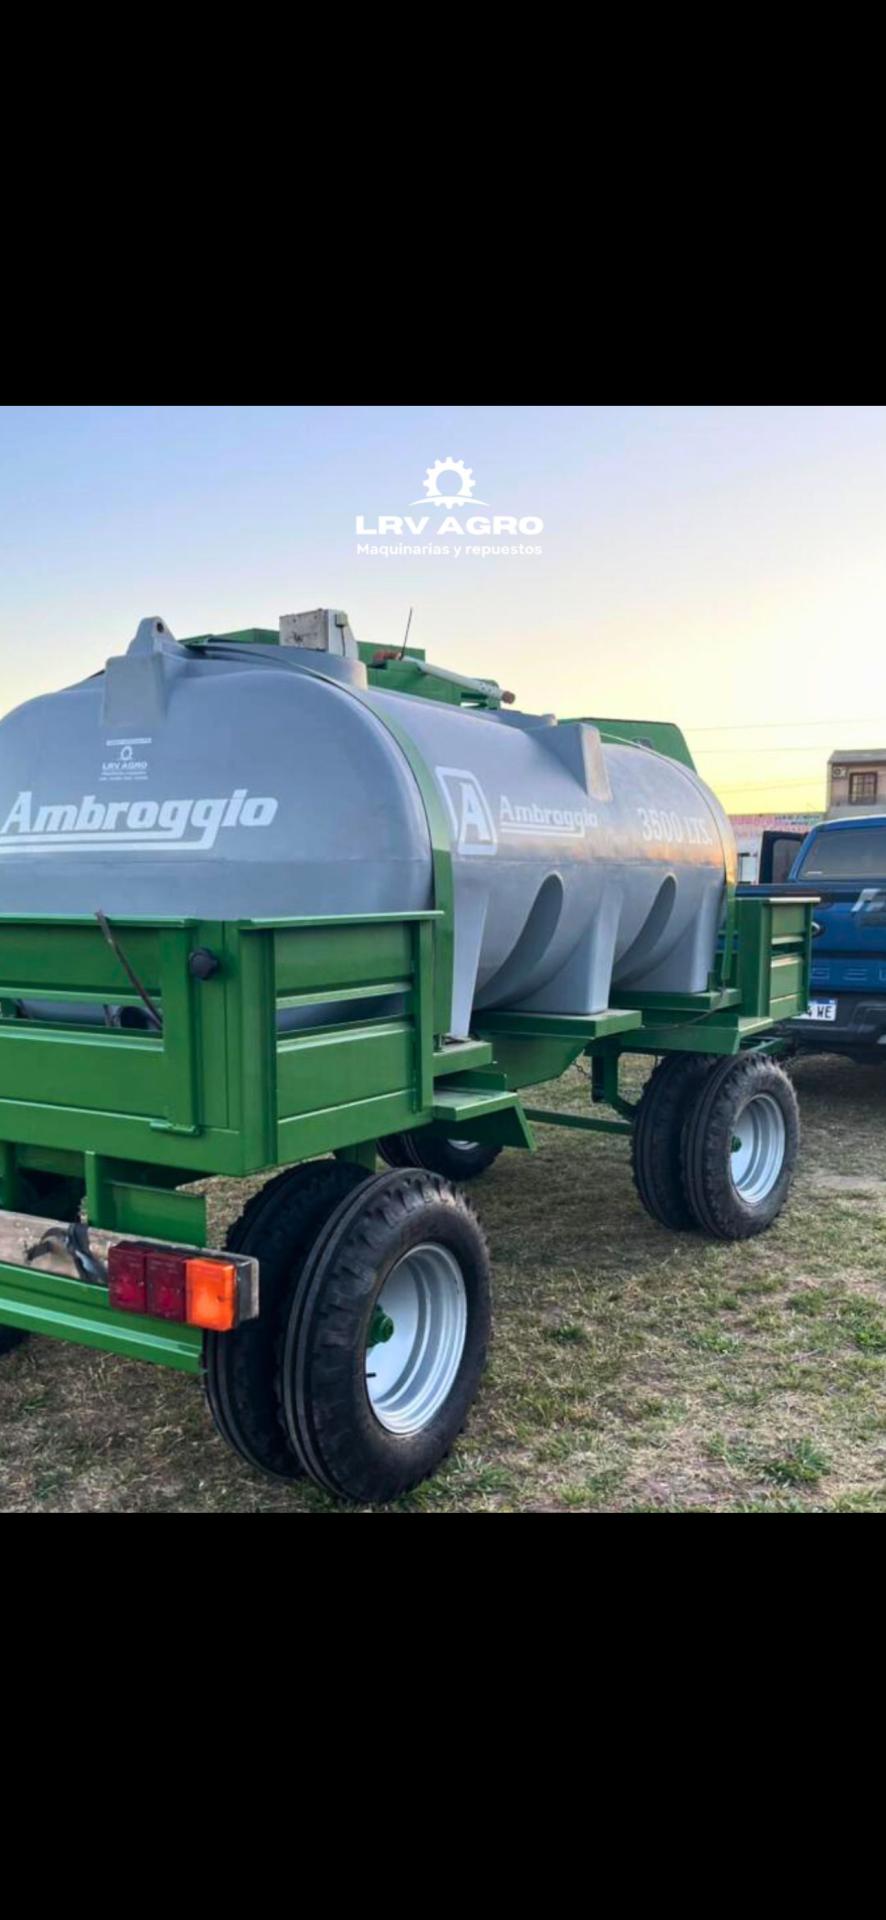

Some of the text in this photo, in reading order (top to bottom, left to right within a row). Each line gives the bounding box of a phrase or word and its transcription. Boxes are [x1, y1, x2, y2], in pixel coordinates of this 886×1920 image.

[0, 789, 279, 853] Ambroggio
[500, 795, 599, 838] Ambroggio
[637, 807, 684, 843] 3500
[817, 1005, 832, 1019] WE
